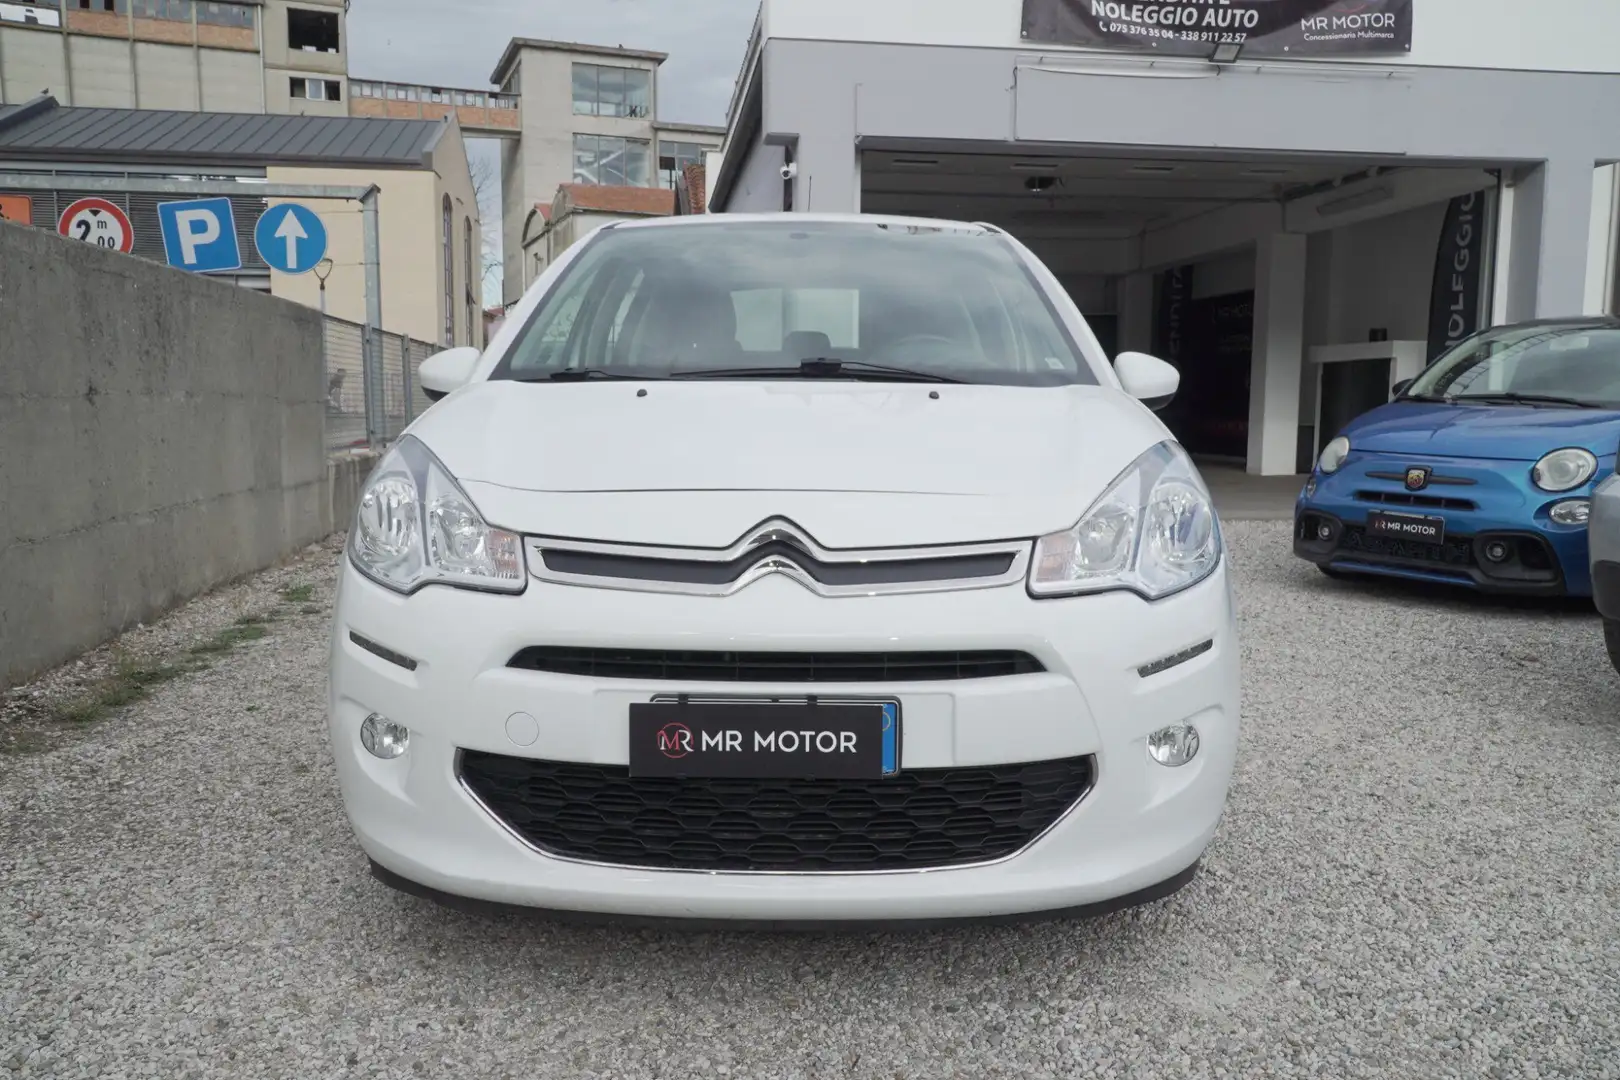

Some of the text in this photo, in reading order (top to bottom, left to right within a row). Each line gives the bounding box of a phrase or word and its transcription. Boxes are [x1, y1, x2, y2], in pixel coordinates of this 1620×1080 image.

[1091, 1, 1259, 28] NOLEGGIO AUTO
[1301, 13, 1395, 30] MR MOTOR
[1109, 22, 1127, 33] 075
[1129, 24, 1147, 35] 376
[1148, 27, 1160, 37] 35
[1161, 28, 1174, 39] 04
[1180, 31, 1199, 41] 338
[1200, 31, 1218, 42] 911
[1220, 32, 1233, 43] 22
[1234, 33, 1247, 43] 57
[1303, 30, 1395, 41] Concessionaria Multimarca
[97, 220, 107, 229] m
[175, 208, 220, 265] P
[1387, 521, 1401, 531] MR
[1402, 523, 1436, 536] MOTOR
[702, 729, 743, 753] MR
[753, 730, 858, 754] MOTOR
